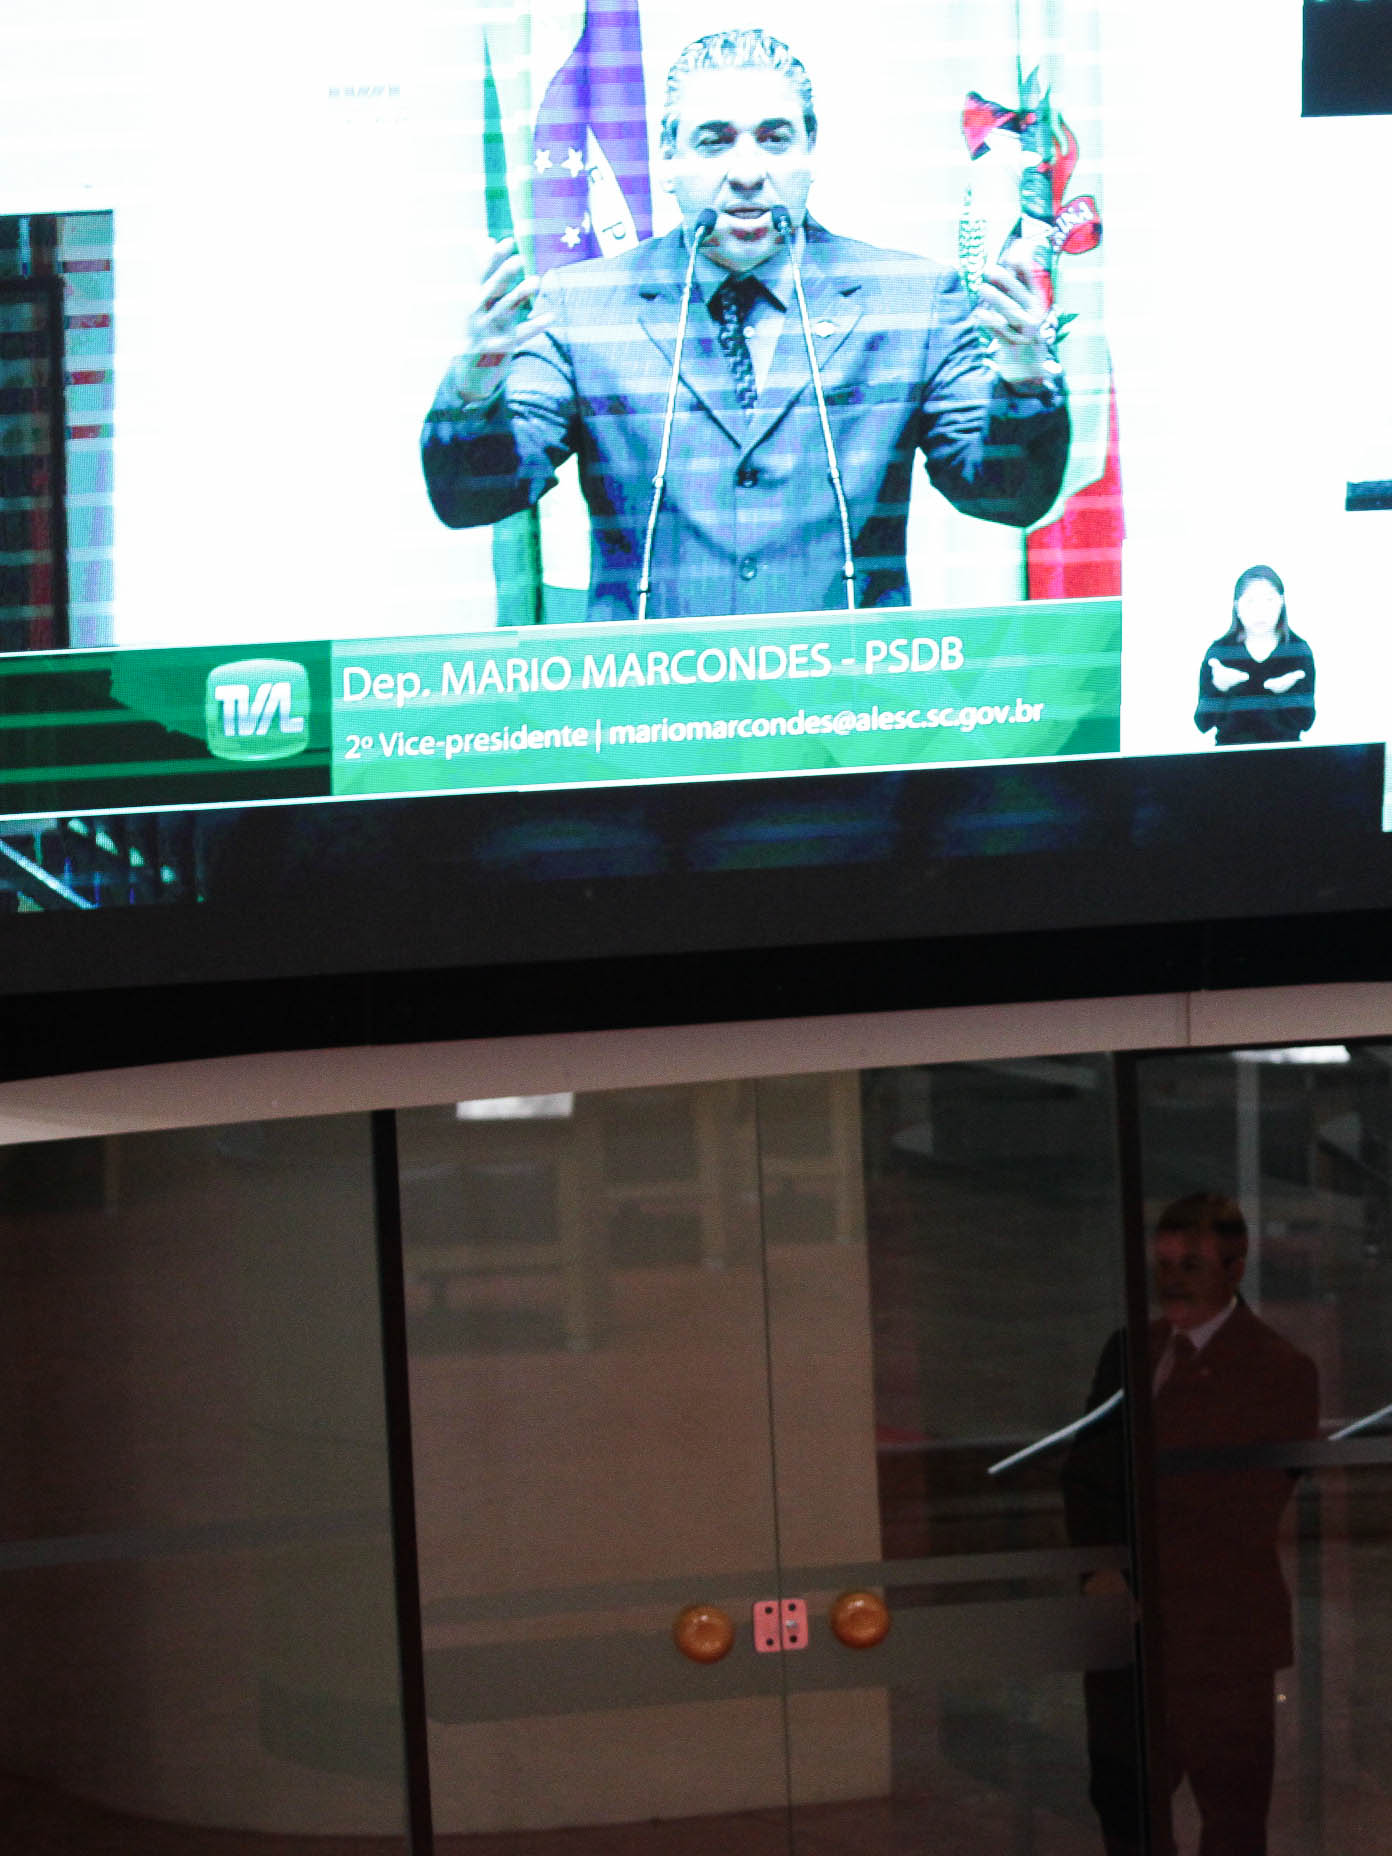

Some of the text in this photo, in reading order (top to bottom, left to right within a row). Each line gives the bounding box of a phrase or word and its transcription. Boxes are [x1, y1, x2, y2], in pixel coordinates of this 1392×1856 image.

[343, 636, 964, 708] Dep. MARIO MARCONDES - PSDB
[379, 724, 589, 760] Vice-presidente
[609, 697, 1044, 745] mariomarcondes@alesc.sc.gov.br
